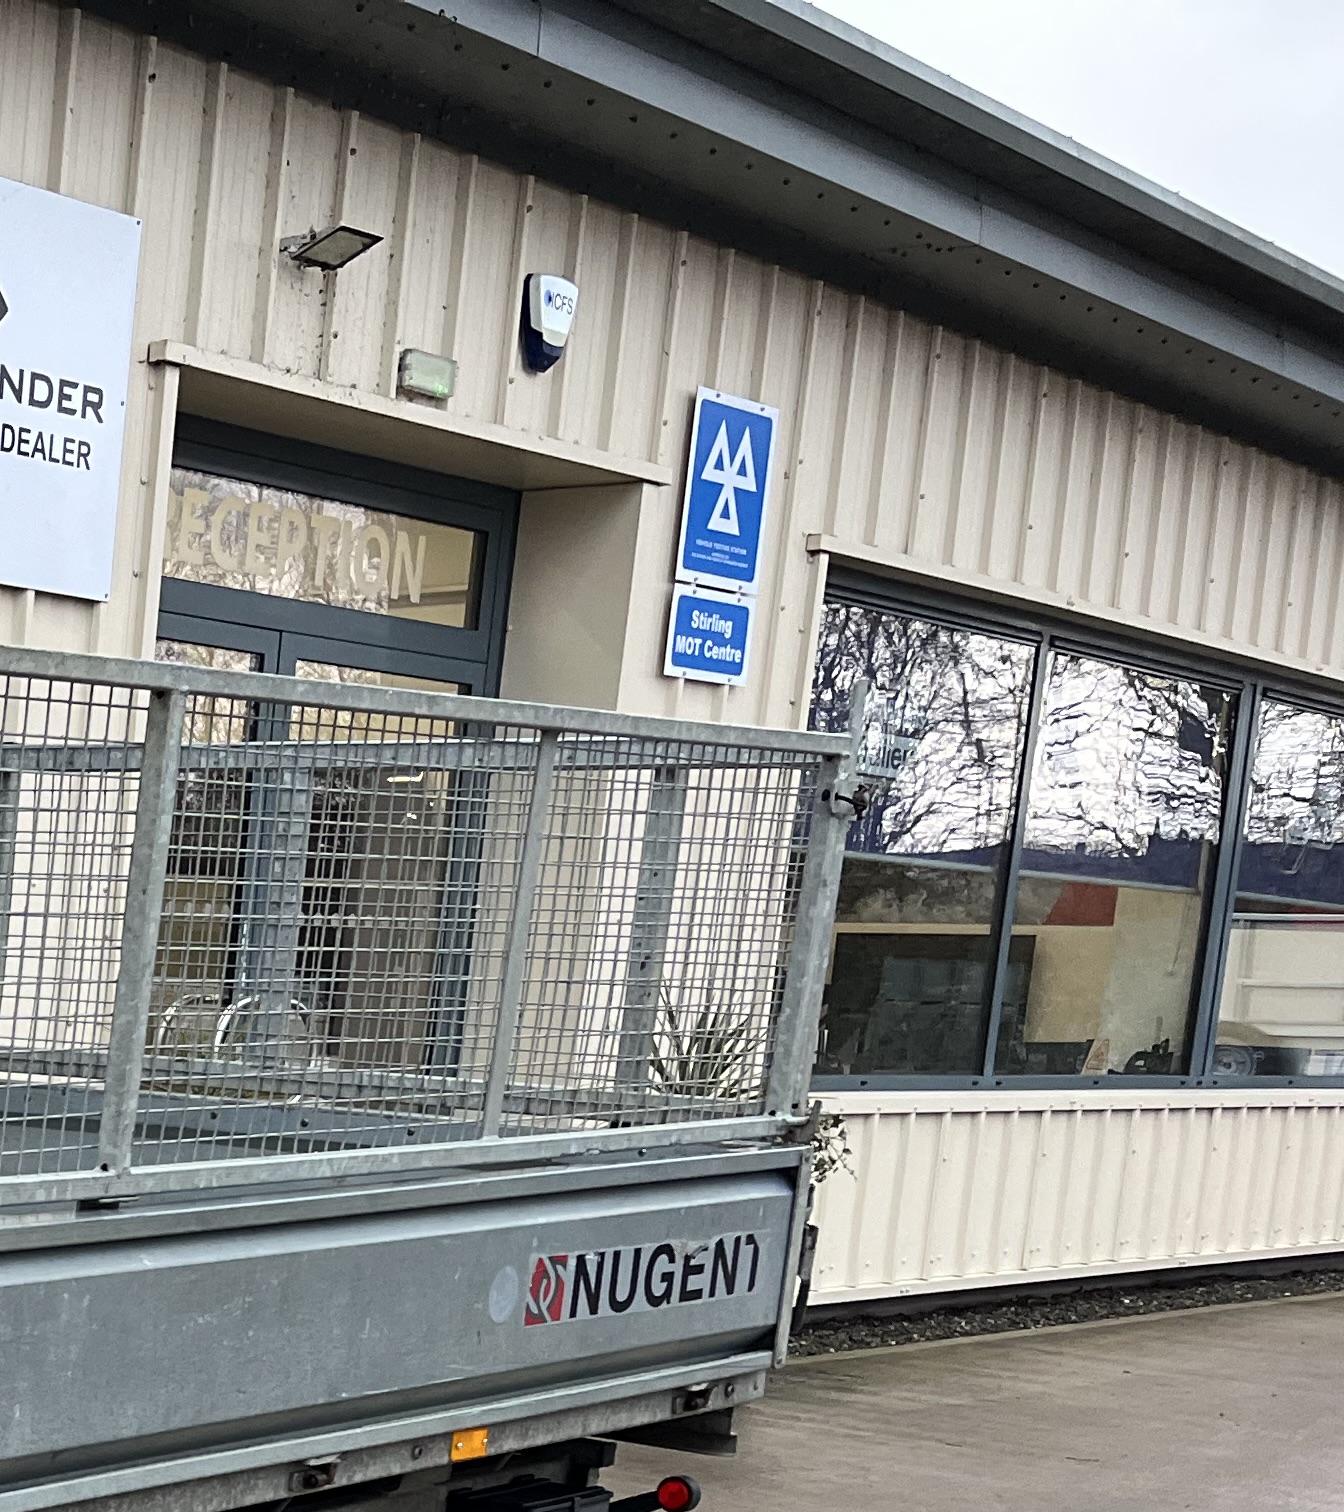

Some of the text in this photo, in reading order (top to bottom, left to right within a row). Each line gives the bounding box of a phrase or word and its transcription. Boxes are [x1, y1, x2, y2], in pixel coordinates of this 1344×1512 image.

[0, 422, 92, 471] DEALER
[691, 609, 733, 639] Stirling
[674, 634, 743, 663] MOT Centre
